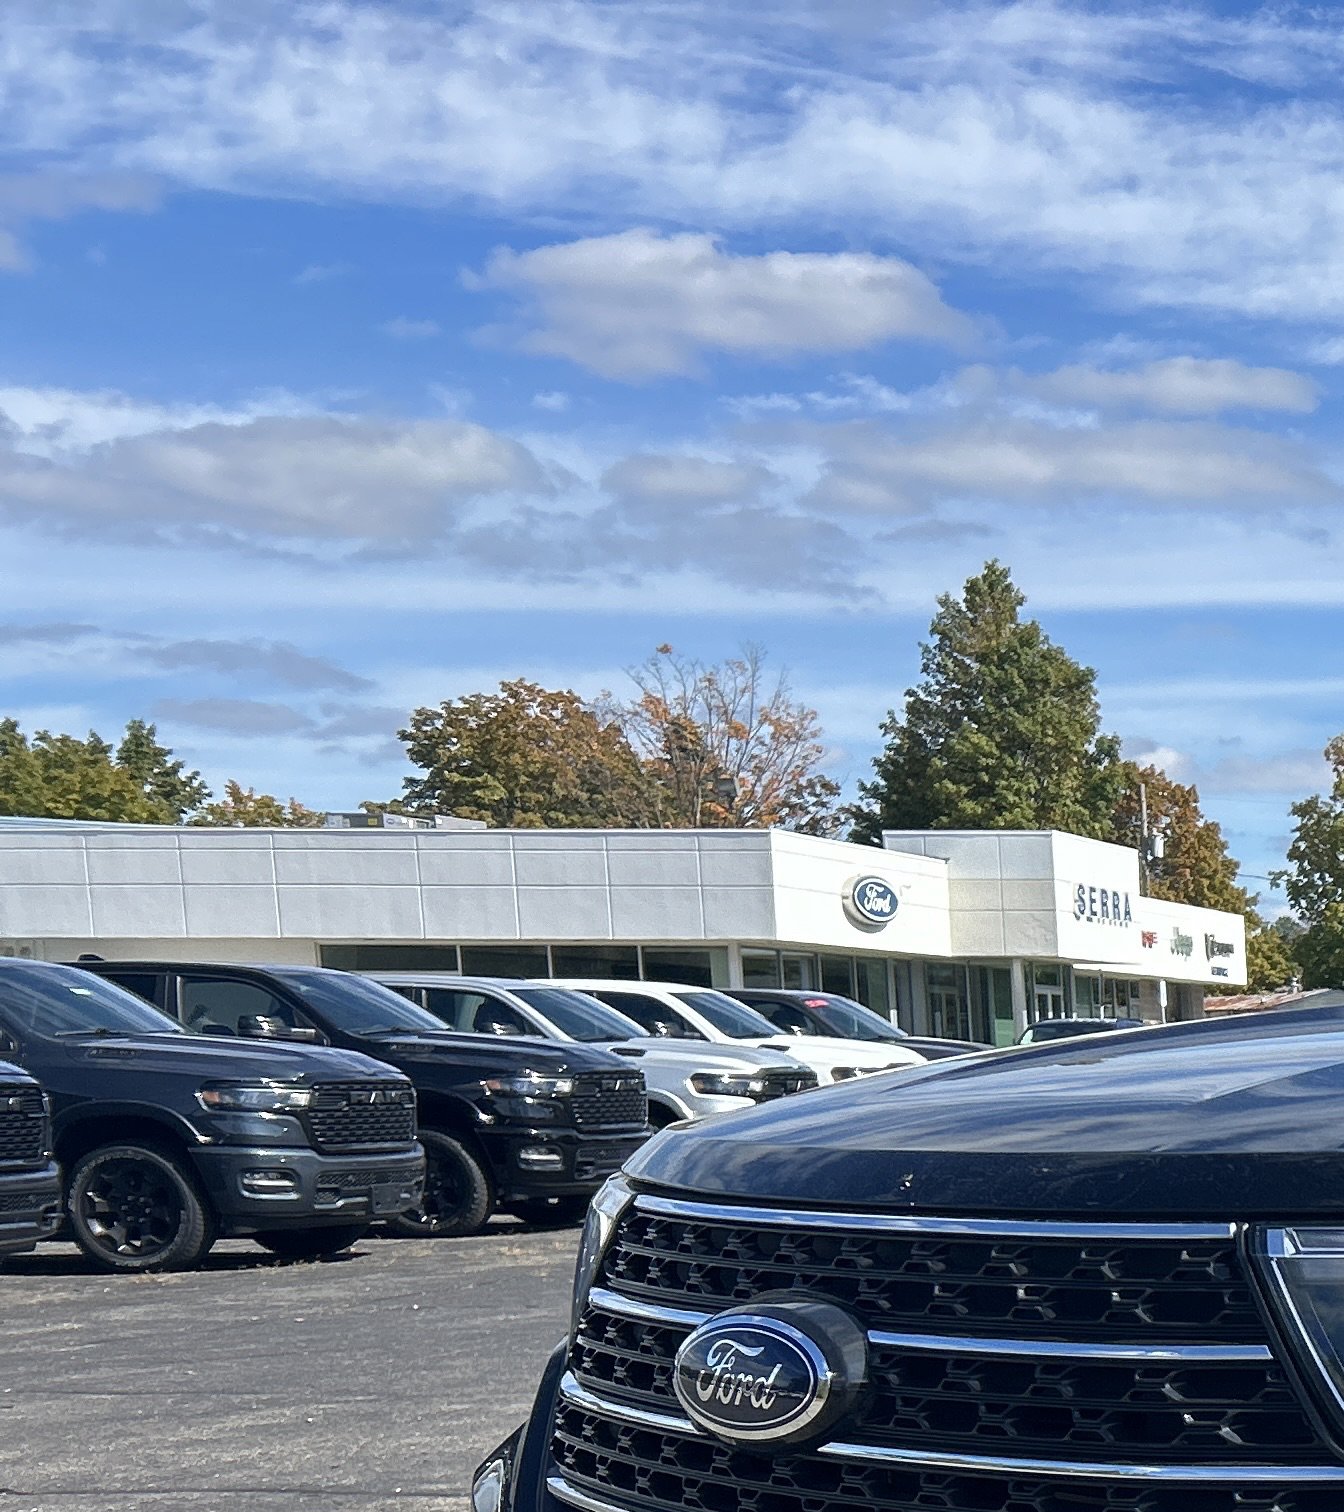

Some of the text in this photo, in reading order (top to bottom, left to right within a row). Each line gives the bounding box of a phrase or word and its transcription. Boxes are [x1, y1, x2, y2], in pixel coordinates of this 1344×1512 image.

[863, 883, 892, 913] Ford
[1077, 883, 1132, 921] SERRA
[696, 1339, 783, 1410] Ford
